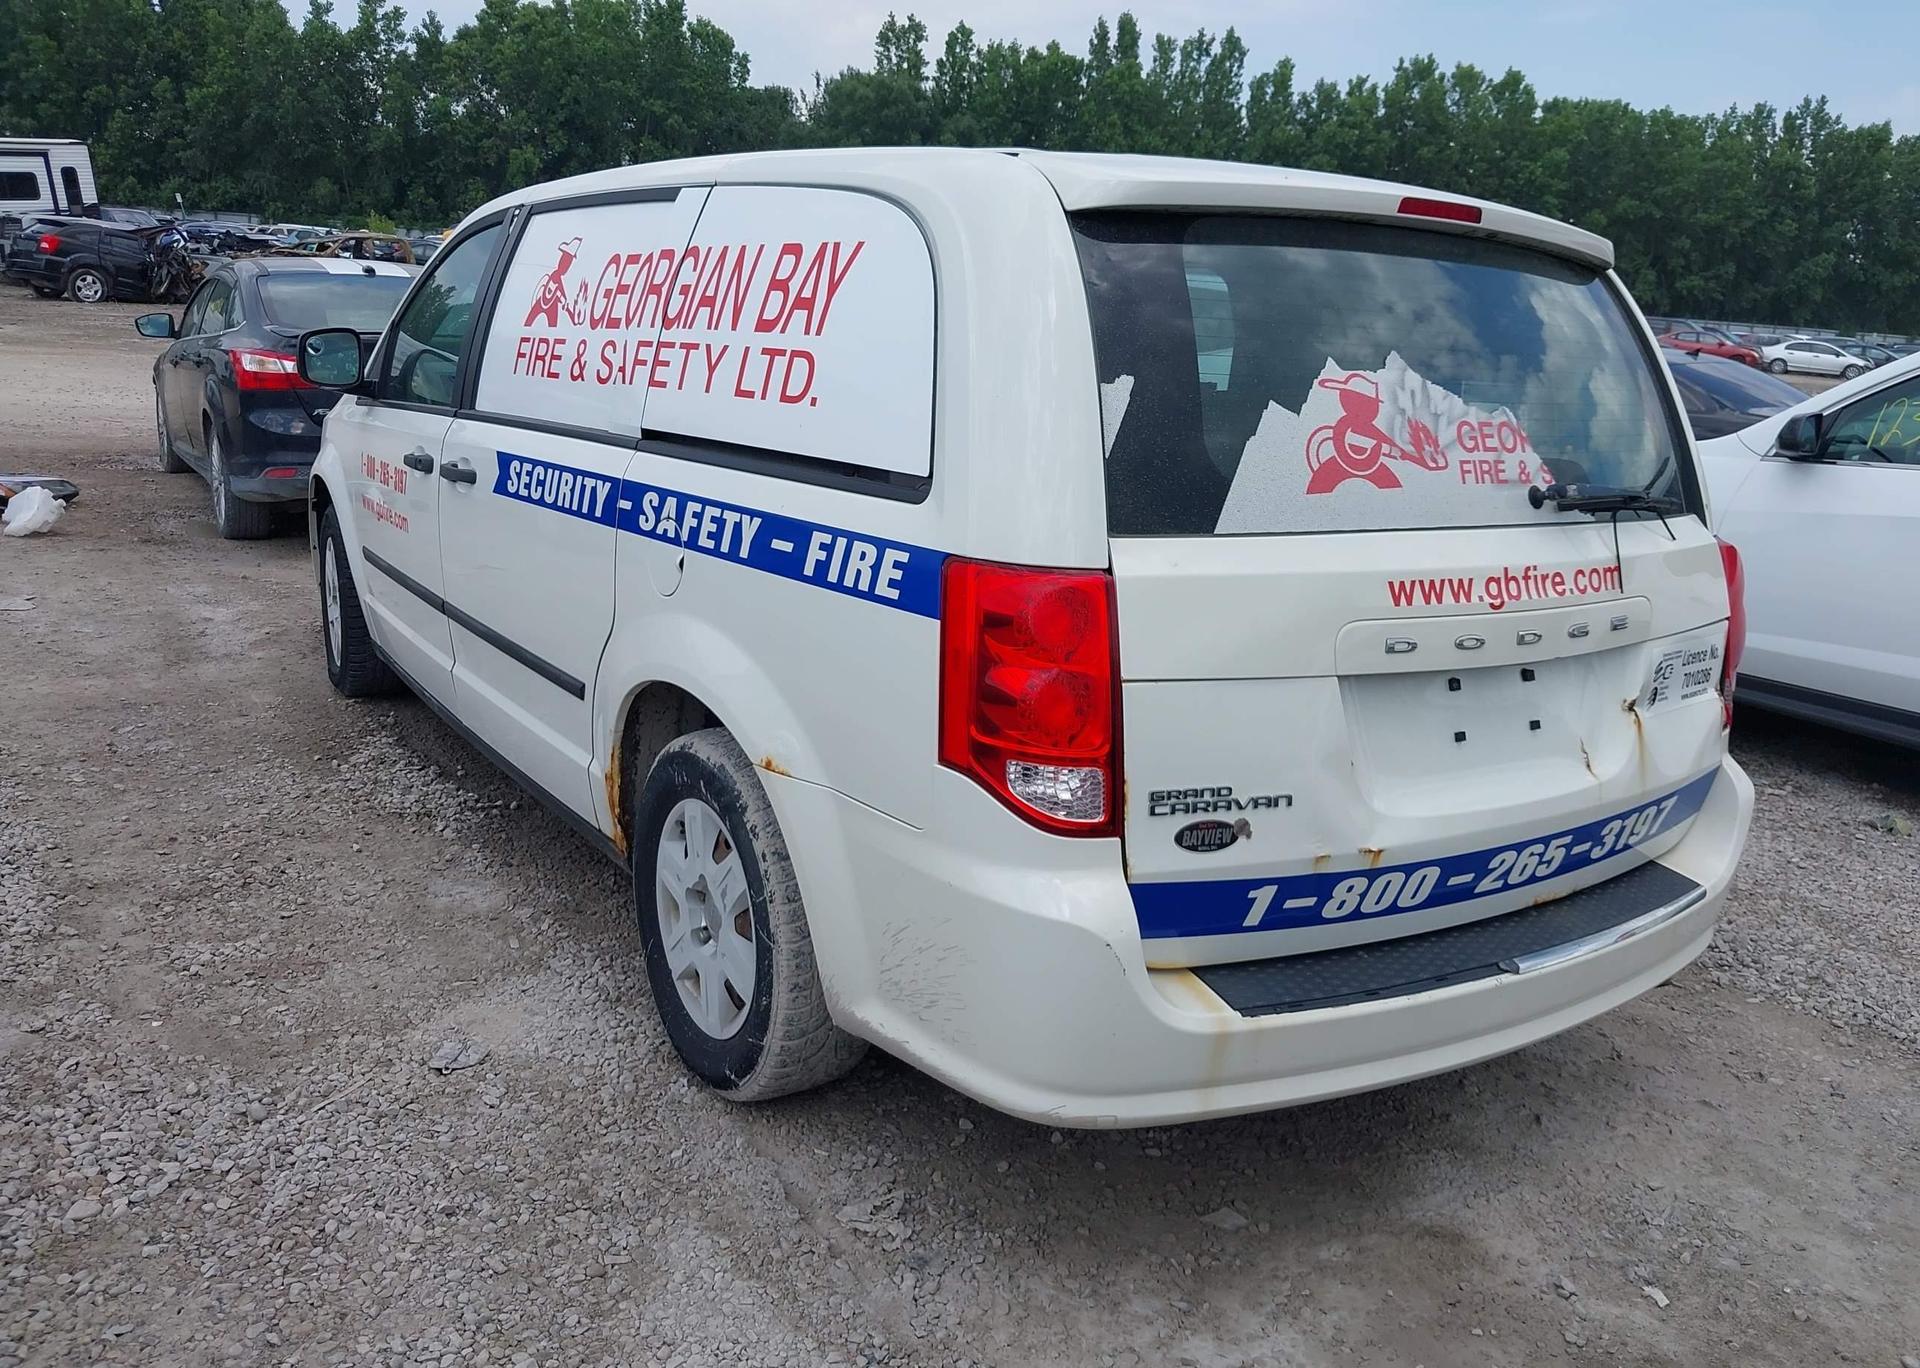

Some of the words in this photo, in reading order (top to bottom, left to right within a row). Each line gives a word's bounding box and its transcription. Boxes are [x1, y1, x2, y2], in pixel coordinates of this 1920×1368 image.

[589, 243, 765, 331] GEORGIAN
[754, 240, 865, 336] BAY
[513, 336, 564, 380] FIRE
[569, 338, 588, 382] &
[596, 339, 728, 393] SAFETY
[734, 345, 818, 407] LTD.
[1459, 459, 1509, 485] FIRE
[1518, 459, 1532, 484] &
[507, 460, 612, 518] SECURITY
[638, 491, 762, 559] SAFETY
[803, 530, 910, 600] FIRE
[1387, 564, 1623, 612] www.gbfire.com
[1384, 615, 1630, 654] DODGE
[1149, 786, 1233, 802] GRAND
[1149, 794, 1293, 817] CARAVAN
[1181, 826, 1234, 847] BAYVIEW
